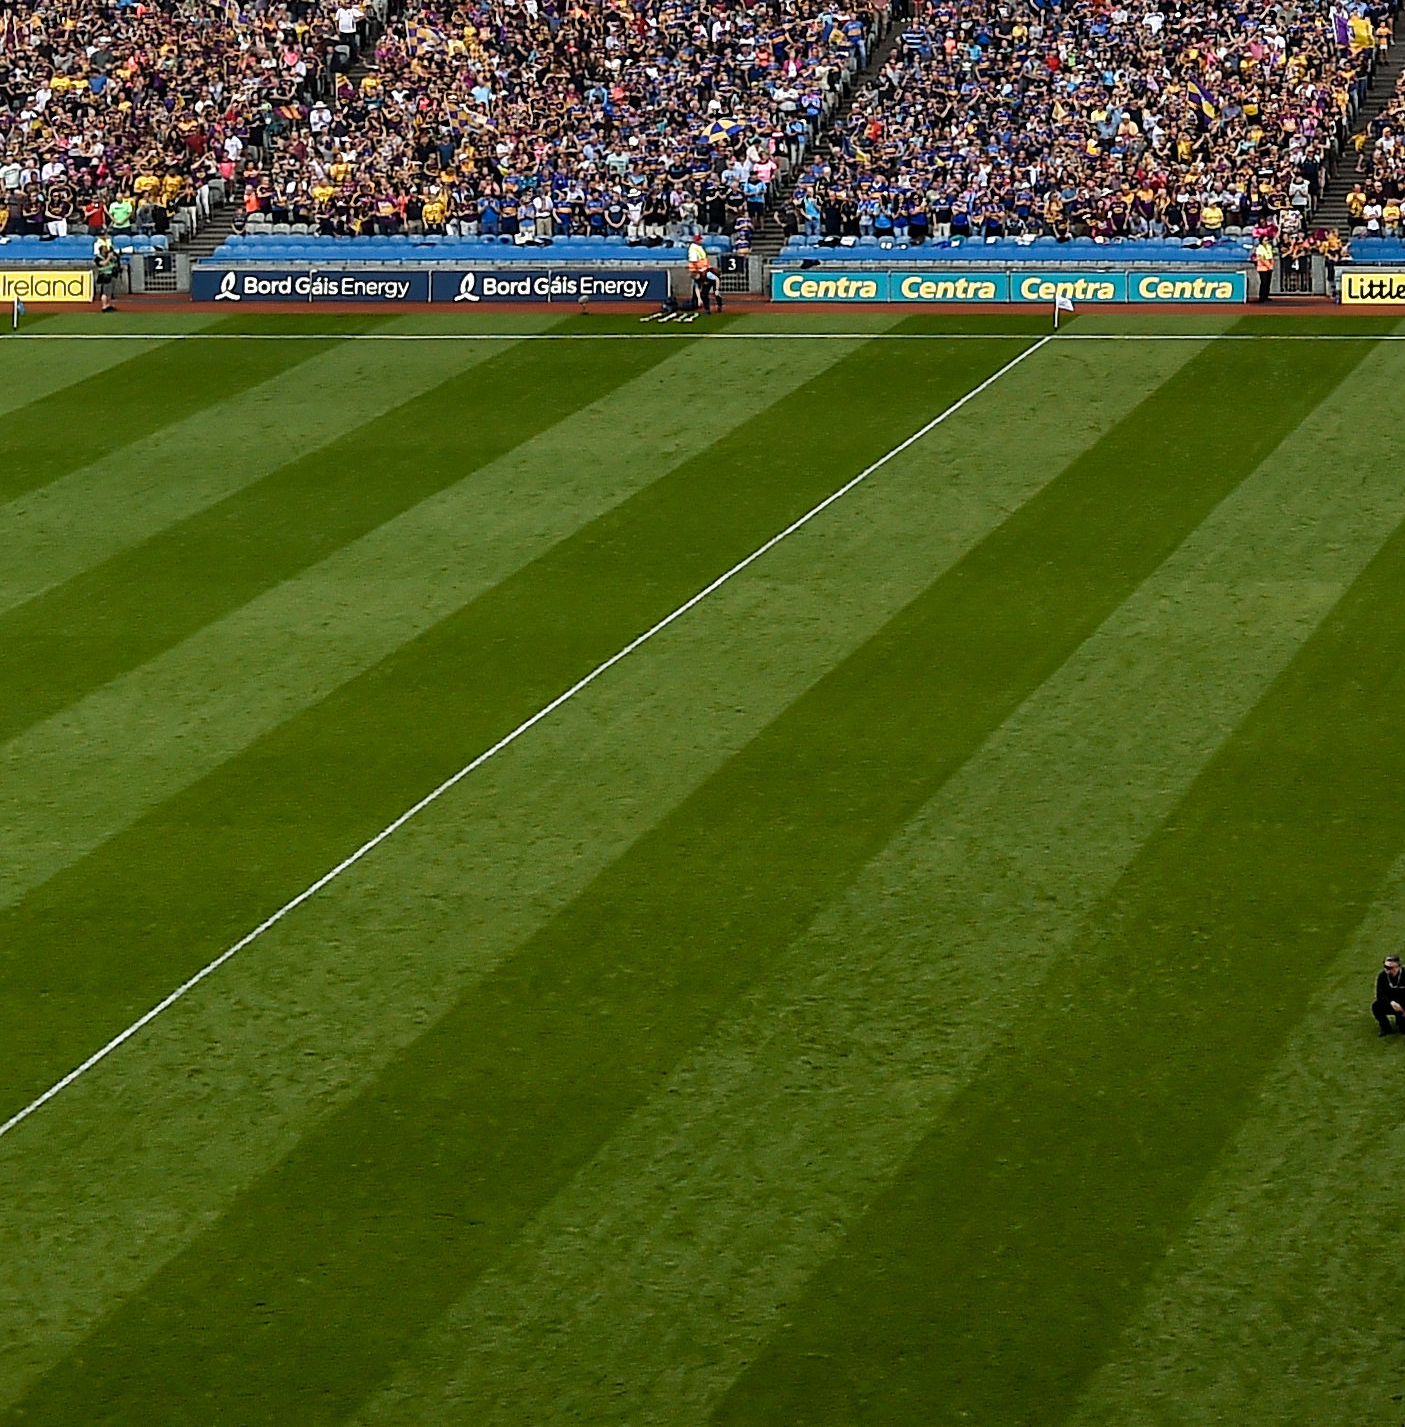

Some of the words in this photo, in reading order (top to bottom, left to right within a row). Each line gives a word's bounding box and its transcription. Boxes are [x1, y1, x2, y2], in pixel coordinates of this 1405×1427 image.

[155, 258, 163, 269] 2
[729, 259, 736, 270] 3
[1292, 260, 1299, 270] 4
[3, 275, 83, 296] Ireland
[244, 277, 291, 294] Bord
[295, 275, 338, 295] Gáis
[342, 278, 409, 298] Energy
[484, 277, 530, 294] Bord
[534, 275, 576, 295] Gáis
[579, 277, 648, 300] Energy
[784, 277, 876, 300] Centra
[1022, 277, 1114, 301] Centra
[1139, 274, 1232, 298] Centra
